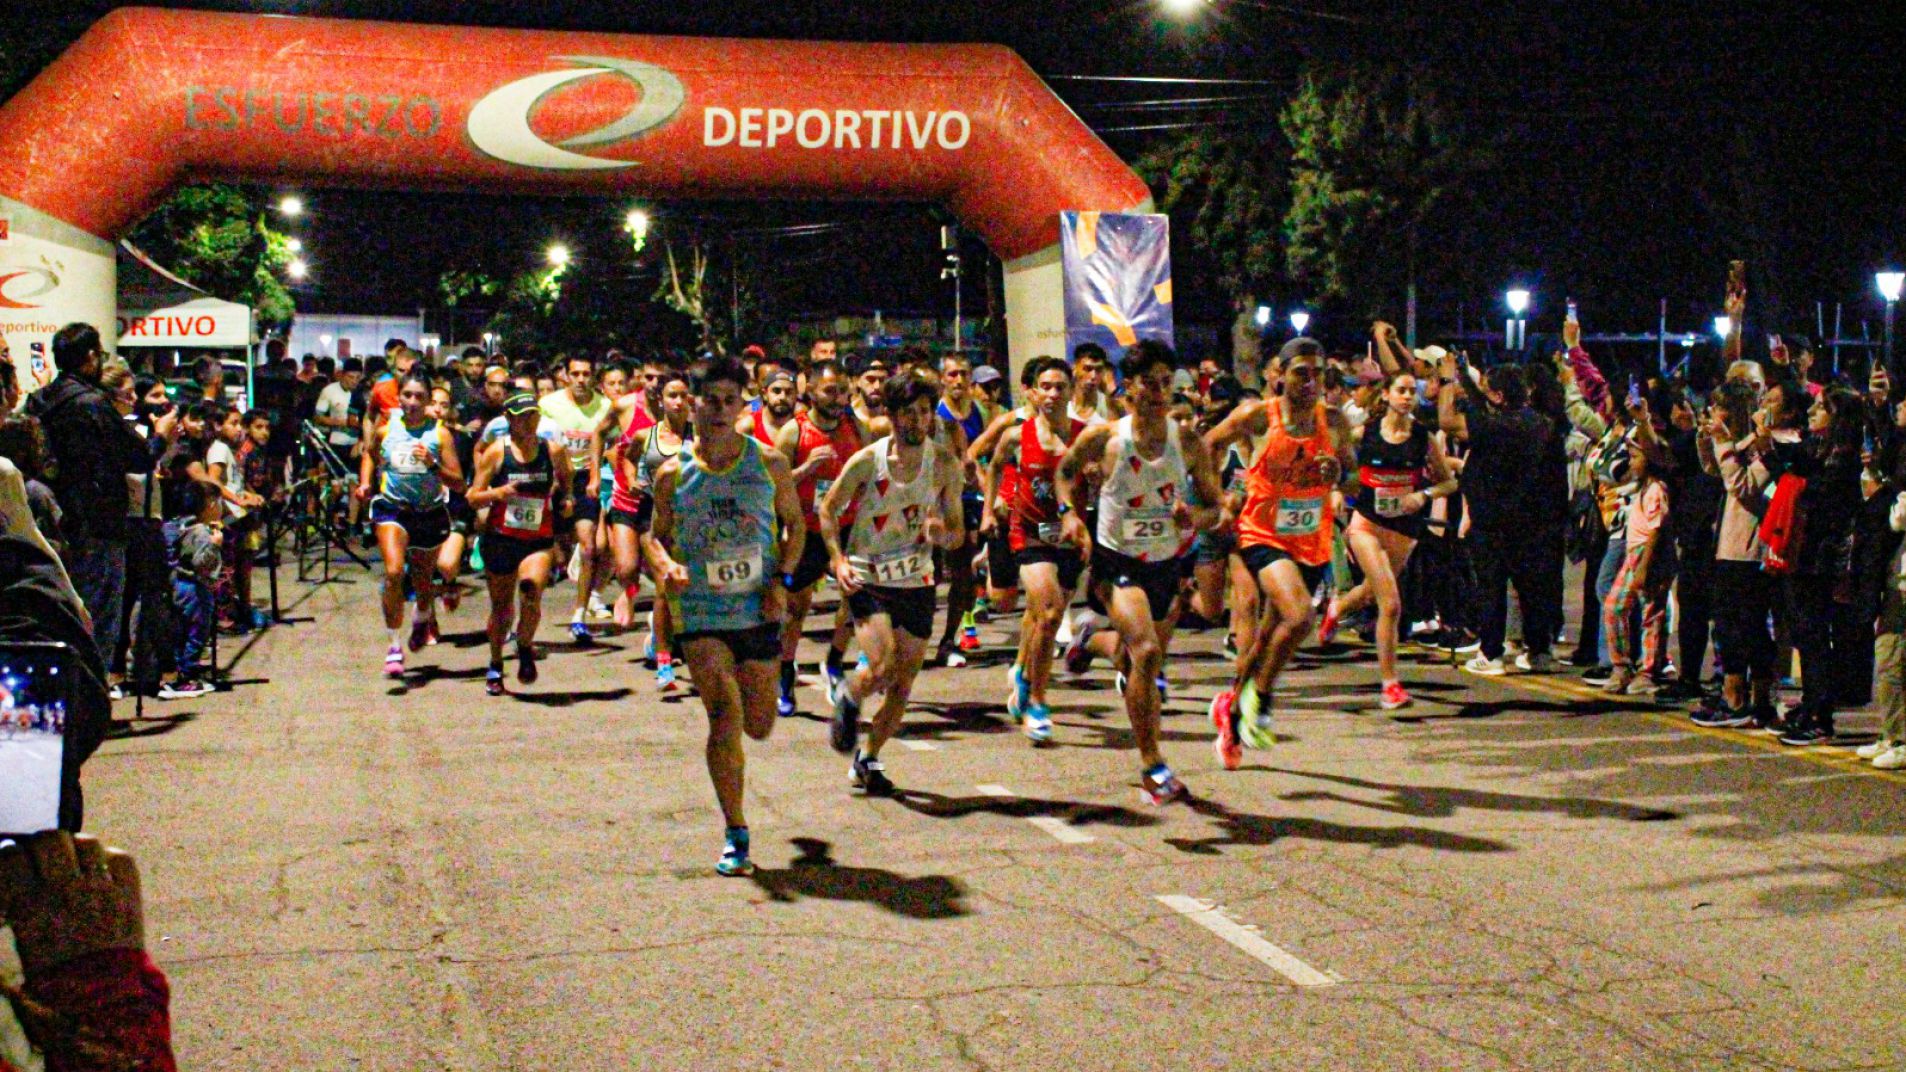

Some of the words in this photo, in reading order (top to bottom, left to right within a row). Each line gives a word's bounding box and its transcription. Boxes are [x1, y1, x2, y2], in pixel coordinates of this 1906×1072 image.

[184, 84, 441, 138] ESFUERZO
[703, 106, 971, 150] DEPORTIVO
[512, 507, 536, 523] 66
[1285, 510, 1315, 528] 30
[1133, 520, 1165, 538] 29
[717, 560, 751, 583] 69
[880, 556, 922, 580] 112
